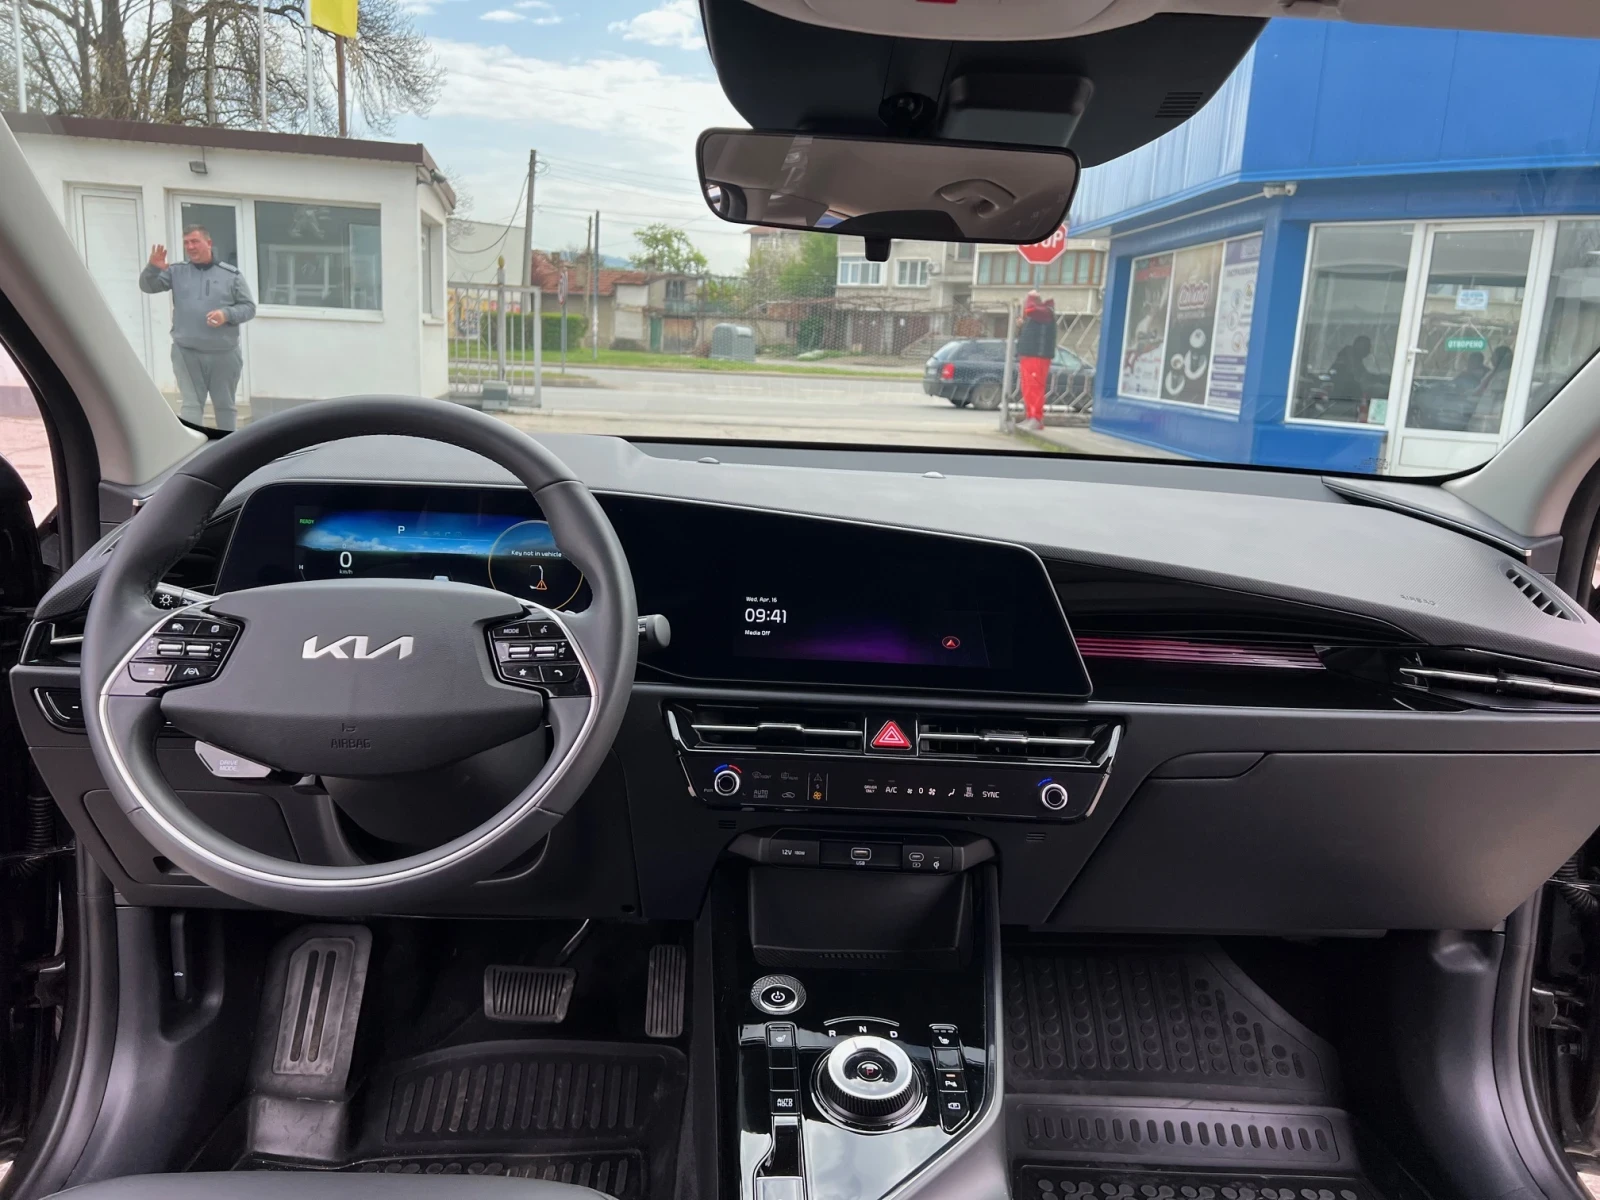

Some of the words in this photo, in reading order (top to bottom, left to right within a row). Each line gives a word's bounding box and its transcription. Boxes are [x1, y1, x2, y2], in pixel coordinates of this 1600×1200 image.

[397, 525, 406, 534] P
[340, 551, 352, 568] 0
[745, 608, 787, 624] 09:41
[302, 635, 414, 660] KIA
[330, 738, 371, 750] AIRBAG
[885, 786, 898, 794] A/C
[982, 790, 1000, 799] SYNC
[828, 1029, 837, 1038] R
[858, 1025, 868, 1034] N
[889, 1030, 899, 1039] D
[865, 1067, 875, 1076] P
